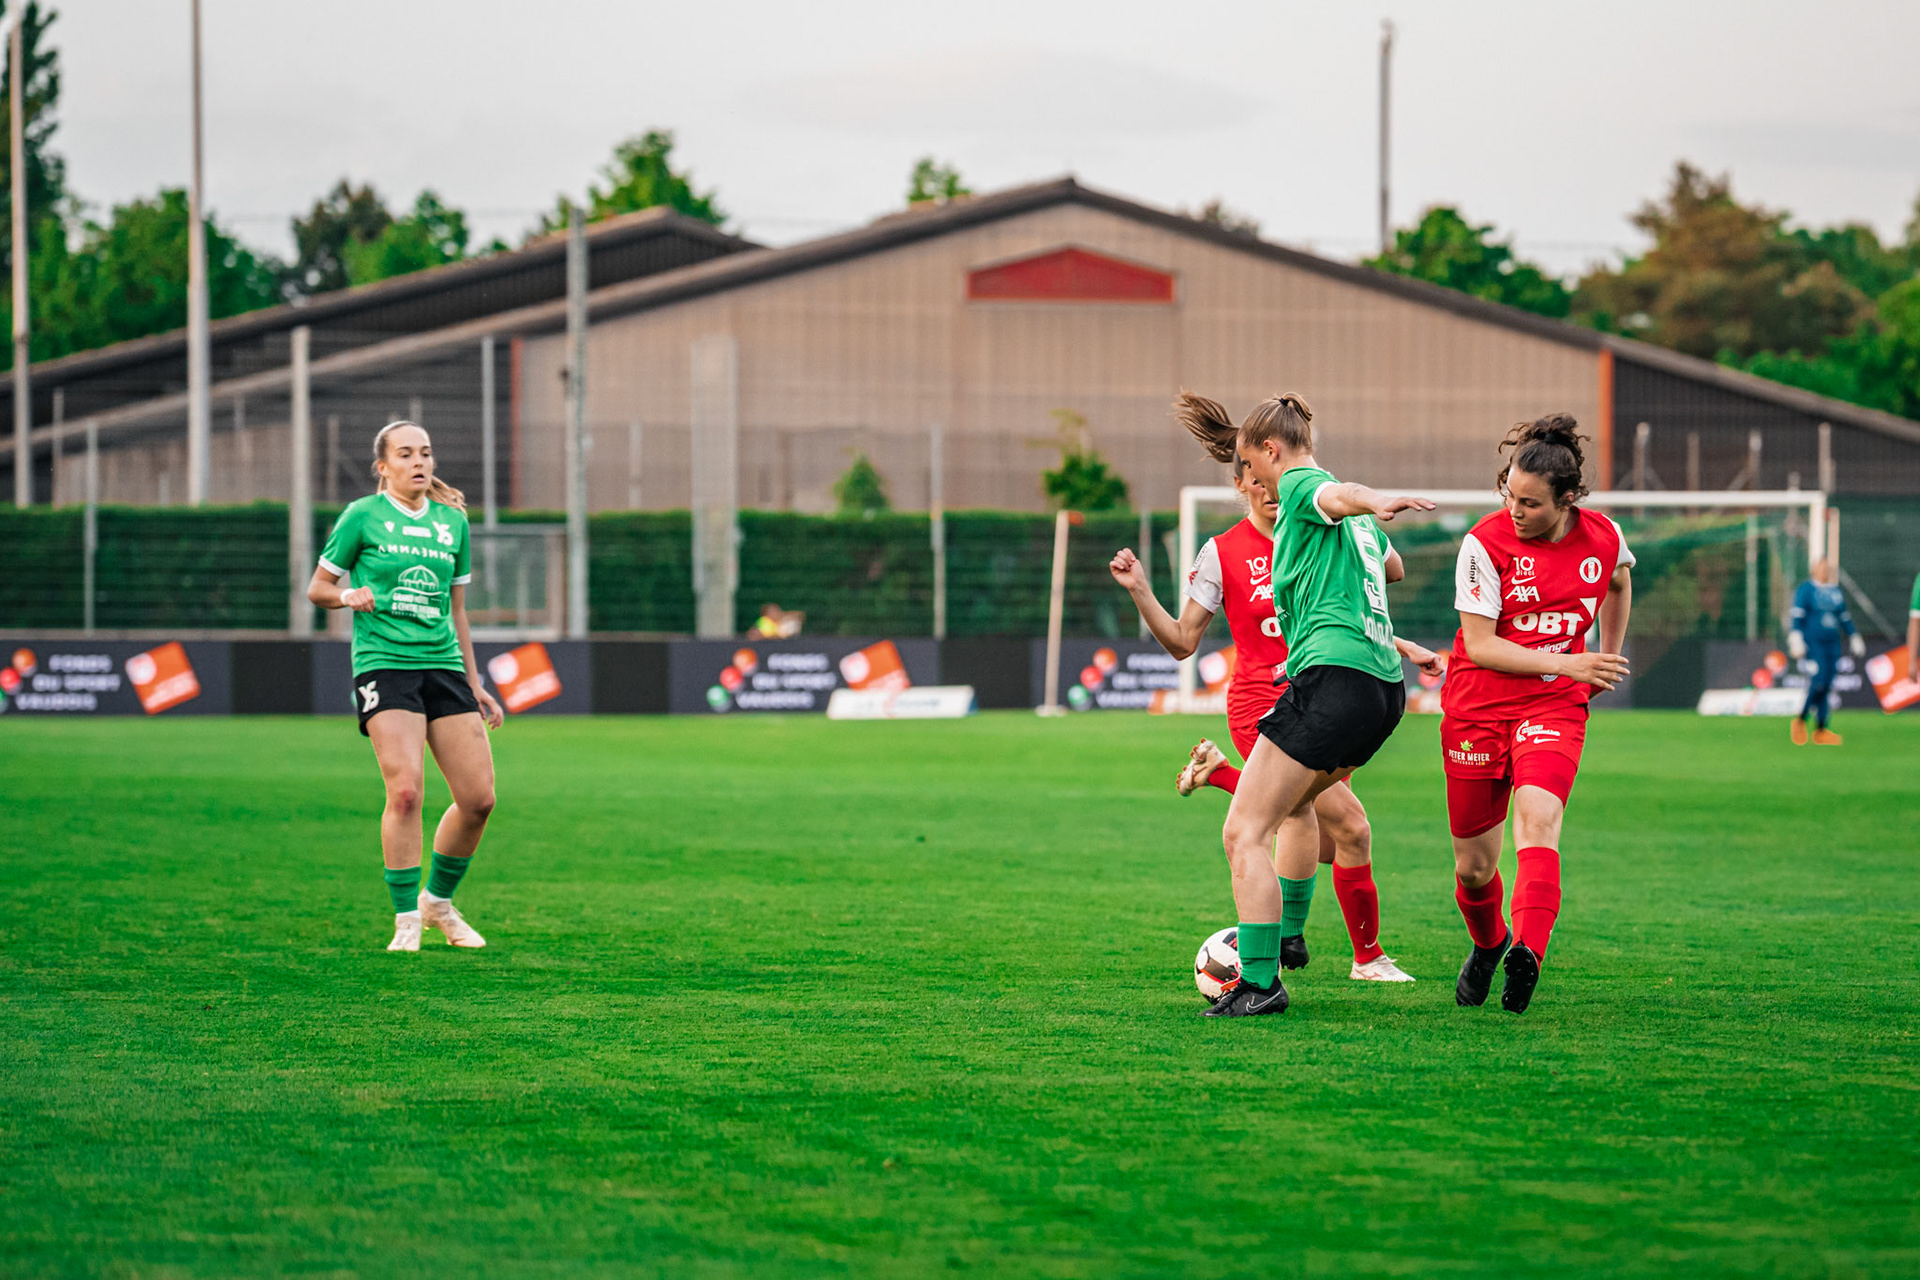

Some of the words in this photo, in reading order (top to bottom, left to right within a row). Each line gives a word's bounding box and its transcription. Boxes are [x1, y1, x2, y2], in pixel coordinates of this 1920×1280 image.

[1504, 586, 1541, 602] AXA
[1512, 611, 1584, 636] OBT
[1448, 749, 1466, 761] PETER
[1467, 752, 1490, 762] MEIER
